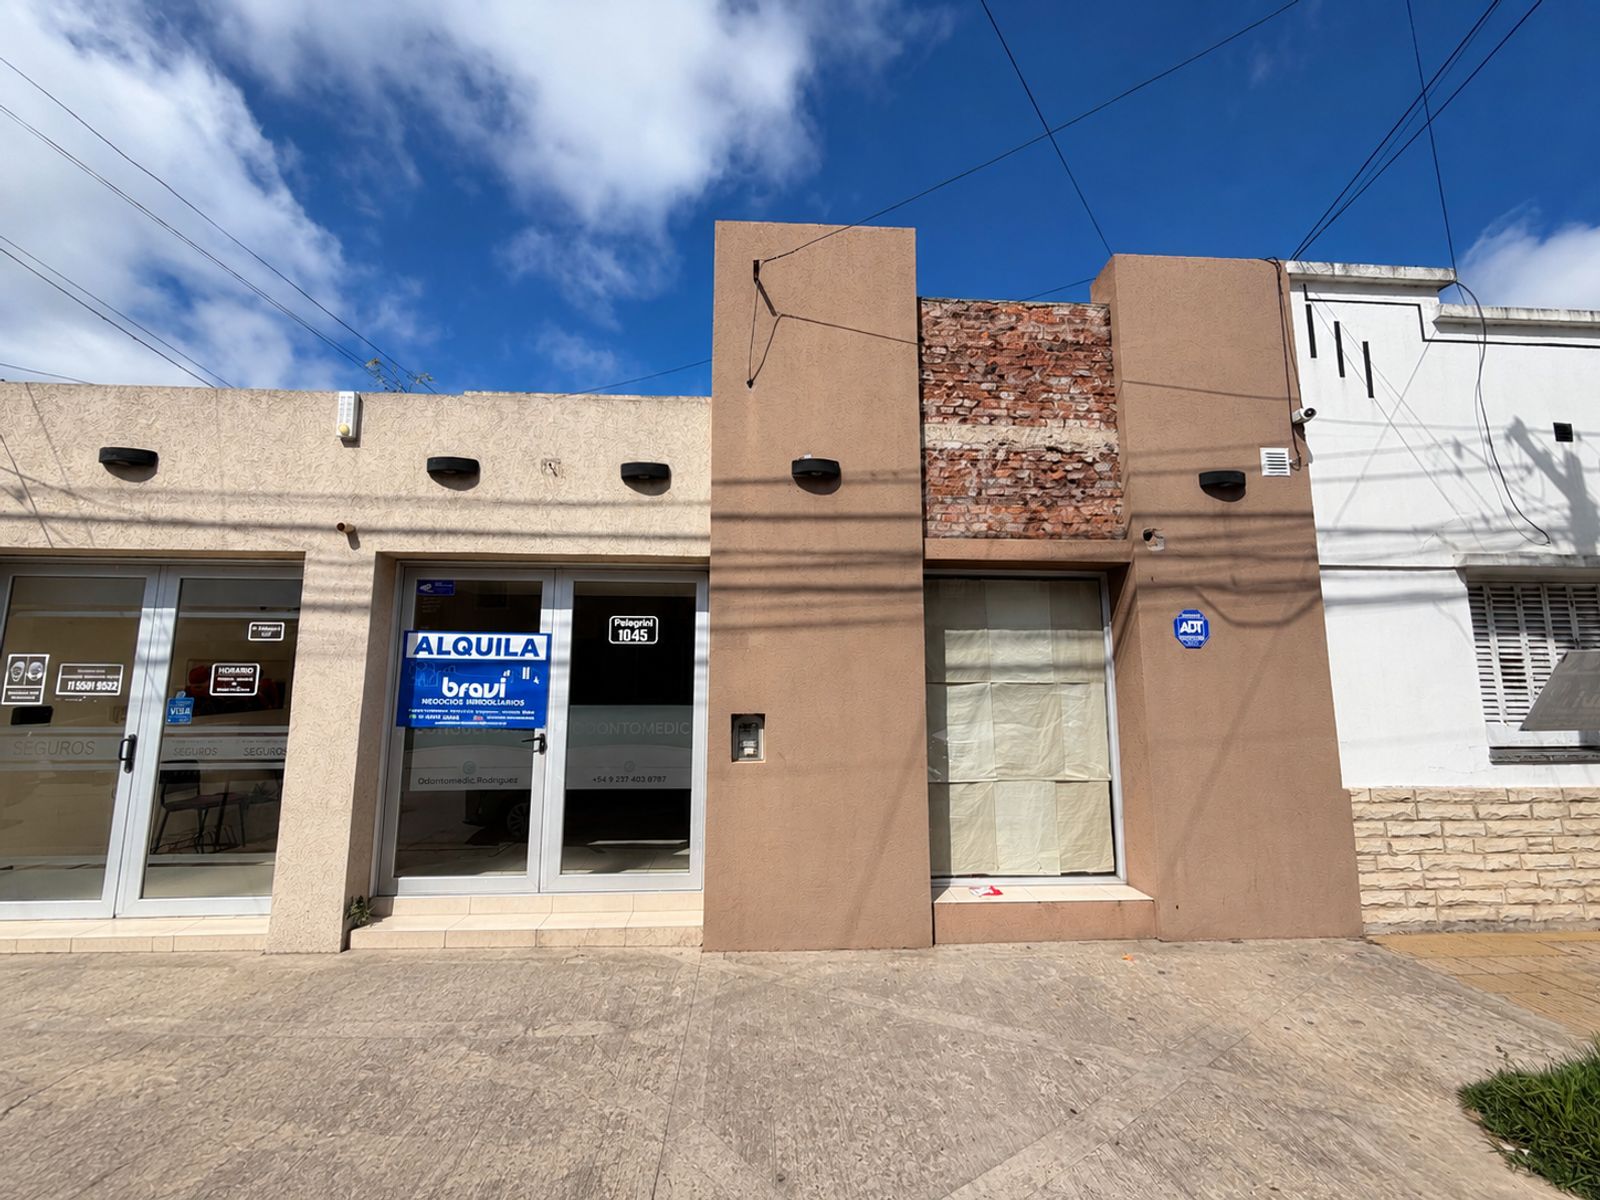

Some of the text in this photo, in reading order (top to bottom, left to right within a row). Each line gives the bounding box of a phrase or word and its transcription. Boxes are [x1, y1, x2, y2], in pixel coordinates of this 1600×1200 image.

[1180, 620, 1203, 634] ADT
[618, 629, 648, 641] 1045
[413, 636, 540, 657] ALQUILA
[442, 676, 507, 698] bravi
[13, 740, 95, 756] SEGUROS
[173, 747, 218, 757] SEGUROS
